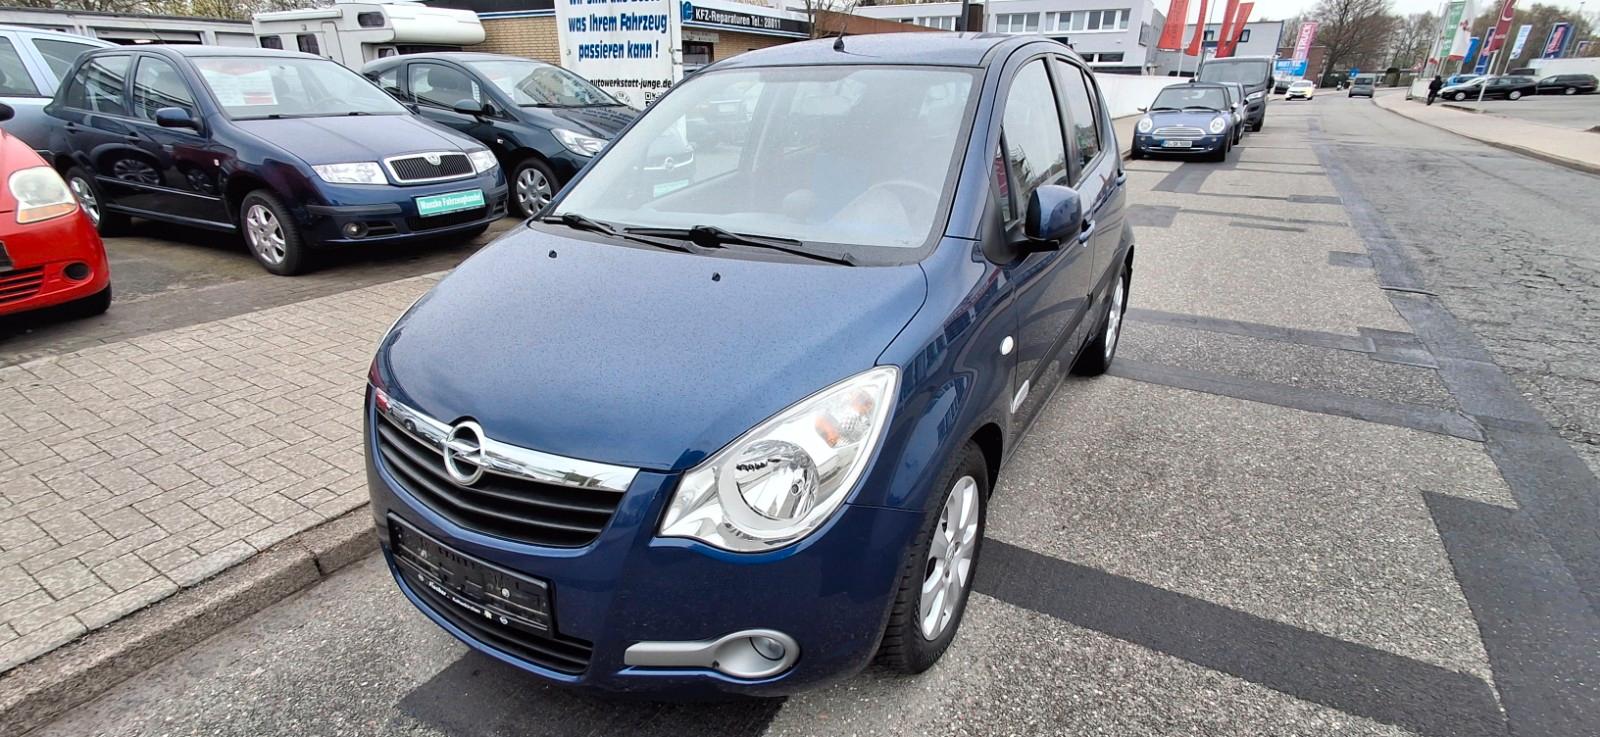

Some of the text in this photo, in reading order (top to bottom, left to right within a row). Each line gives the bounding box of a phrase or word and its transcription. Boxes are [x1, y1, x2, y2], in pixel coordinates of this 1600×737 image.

[568, 12, 668, 34] was Ihrem Fahrzeug
[695, 8, 750, 25] KFZ-Reparaturen
[578, 40, 625, 61] passieren
[627, 39, 652, 59] kann
